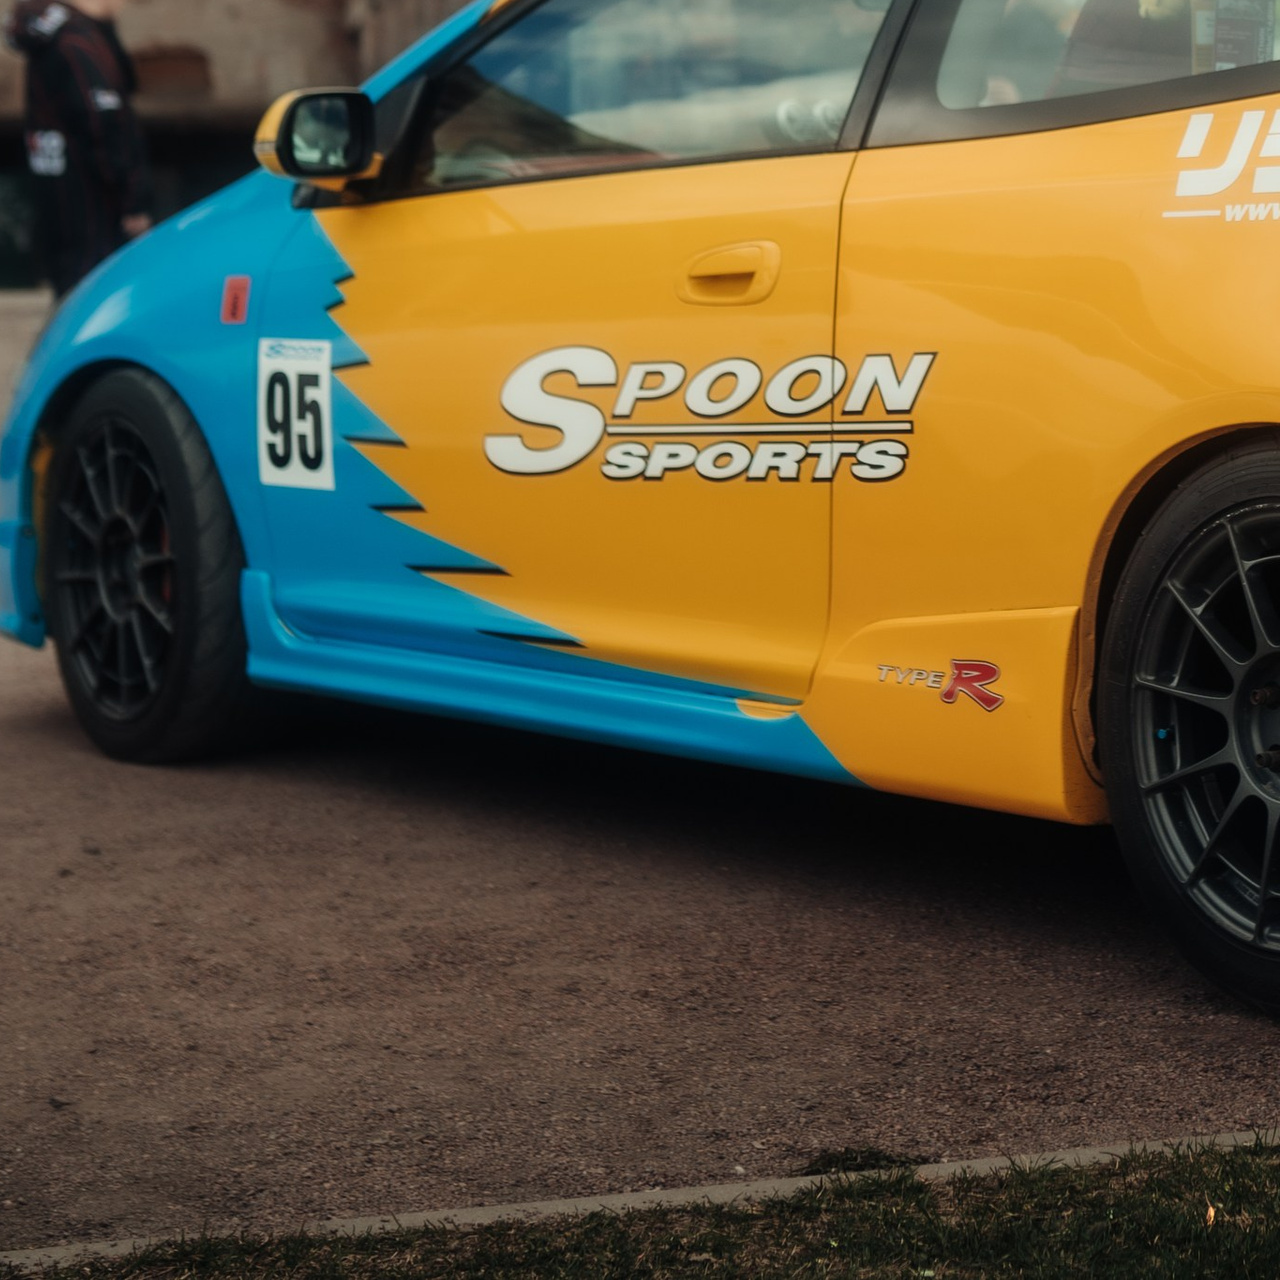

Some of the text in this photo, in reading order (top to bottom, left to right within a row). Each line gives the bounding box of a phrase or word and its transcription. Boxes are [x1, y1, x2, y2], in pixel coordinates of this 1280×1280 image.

[266, 371, 323, 470] 95
[484, 345, 938, 475] SPOON
[600, 439, 909, 482] SPORTS
[877, 658, 1005, 713] TYPE R
